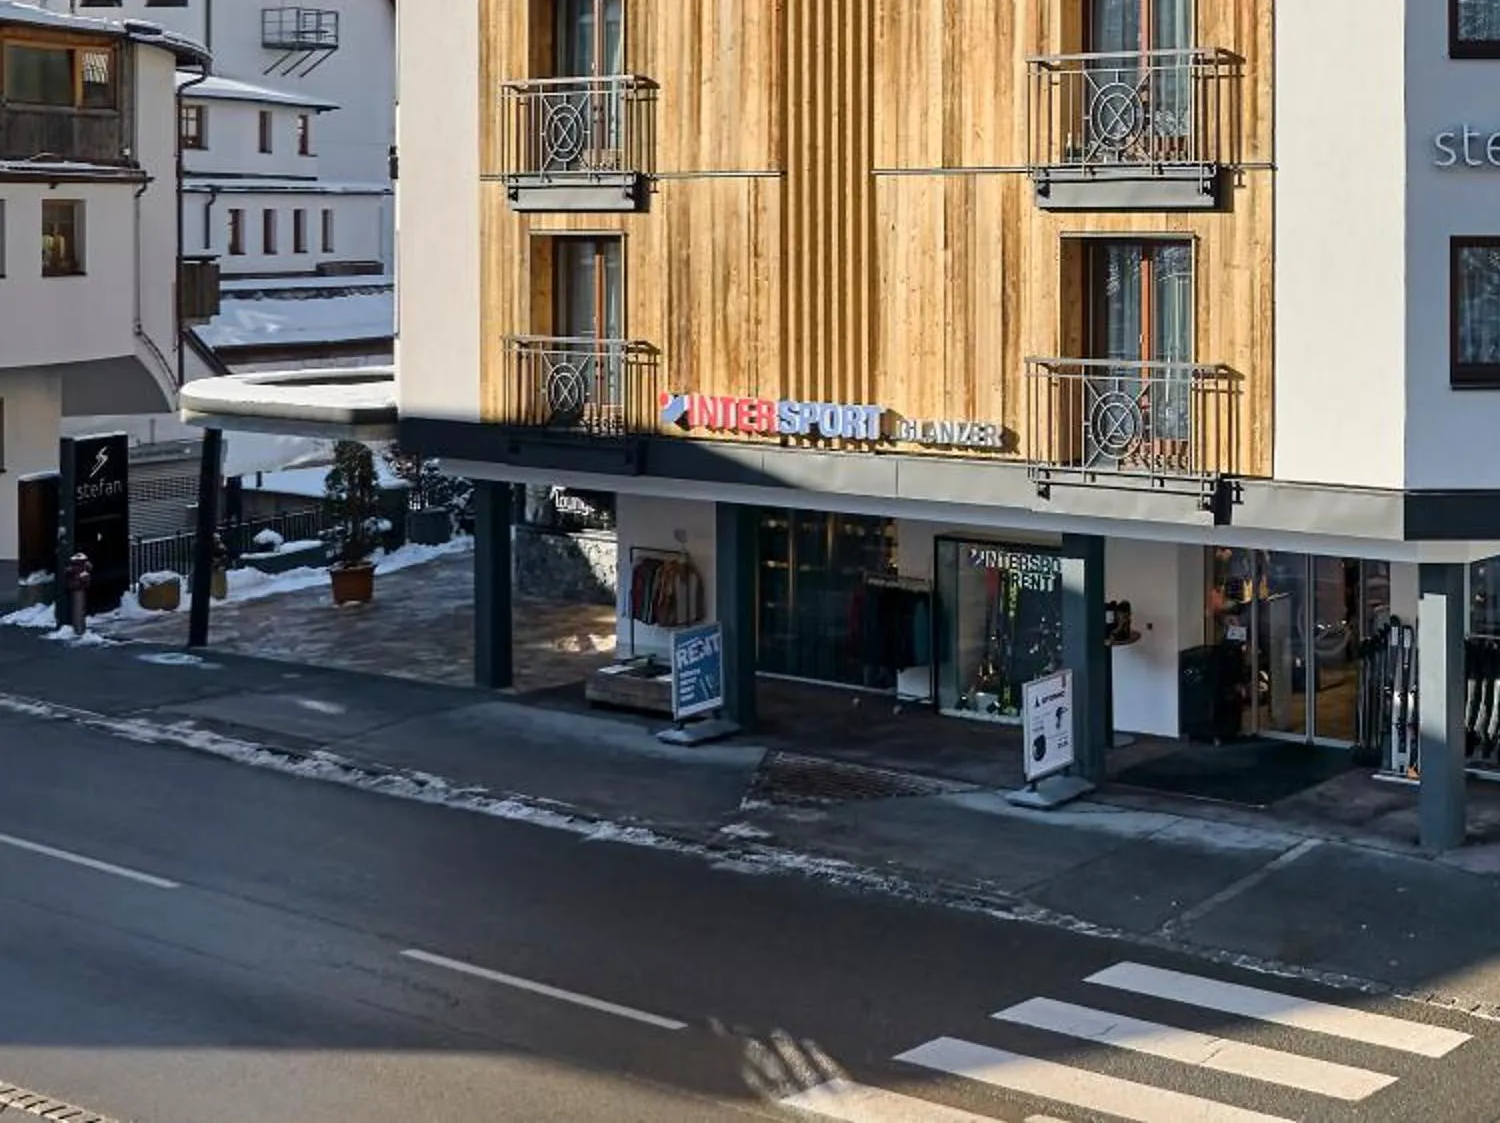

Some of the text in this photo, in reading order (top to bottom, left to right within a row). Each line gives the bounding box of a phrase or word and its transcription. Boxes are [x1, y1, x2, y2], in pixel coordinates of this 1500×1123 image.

[688, 395, 1003, 447] INTERSPORT GLANZER
[77, 478, 122, 501] stefan
